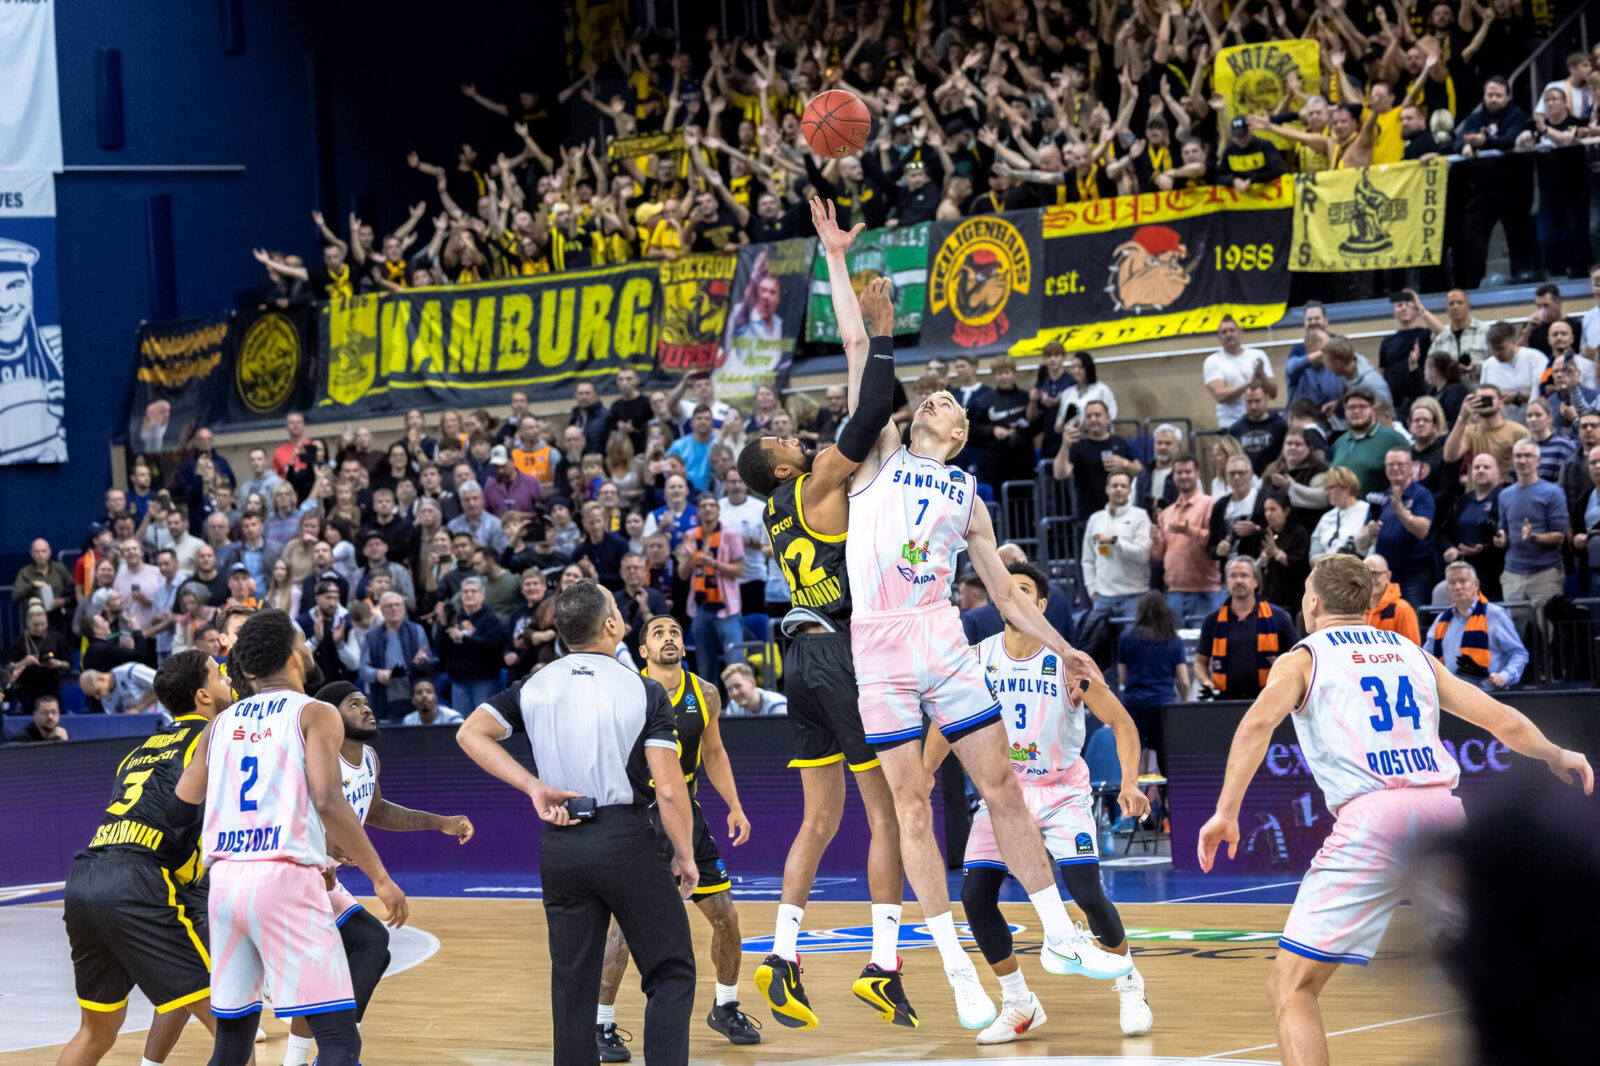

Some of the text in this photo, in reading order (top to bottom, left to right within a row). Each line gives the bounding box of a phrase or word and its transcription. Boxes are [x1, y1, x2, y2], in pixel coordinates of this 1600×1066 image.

[1215, 244, 1275, 271] 1988
[1045, 270, 1085, 296] est.
[381, 277, 653, 377] HAMBURG
[915, 499, 929, 525] 7
[913, 574, 936, 584] AIDA
[1369, 653, 1405, 663] OSPA
[1015, 703, 1026, 729] 3
[1360, 676, 1421, 732] 34
[106, 768, 154, 816] 3
[240, 756, 258, 812] 2
[213, 826, 281, 852] ROSTOCK
